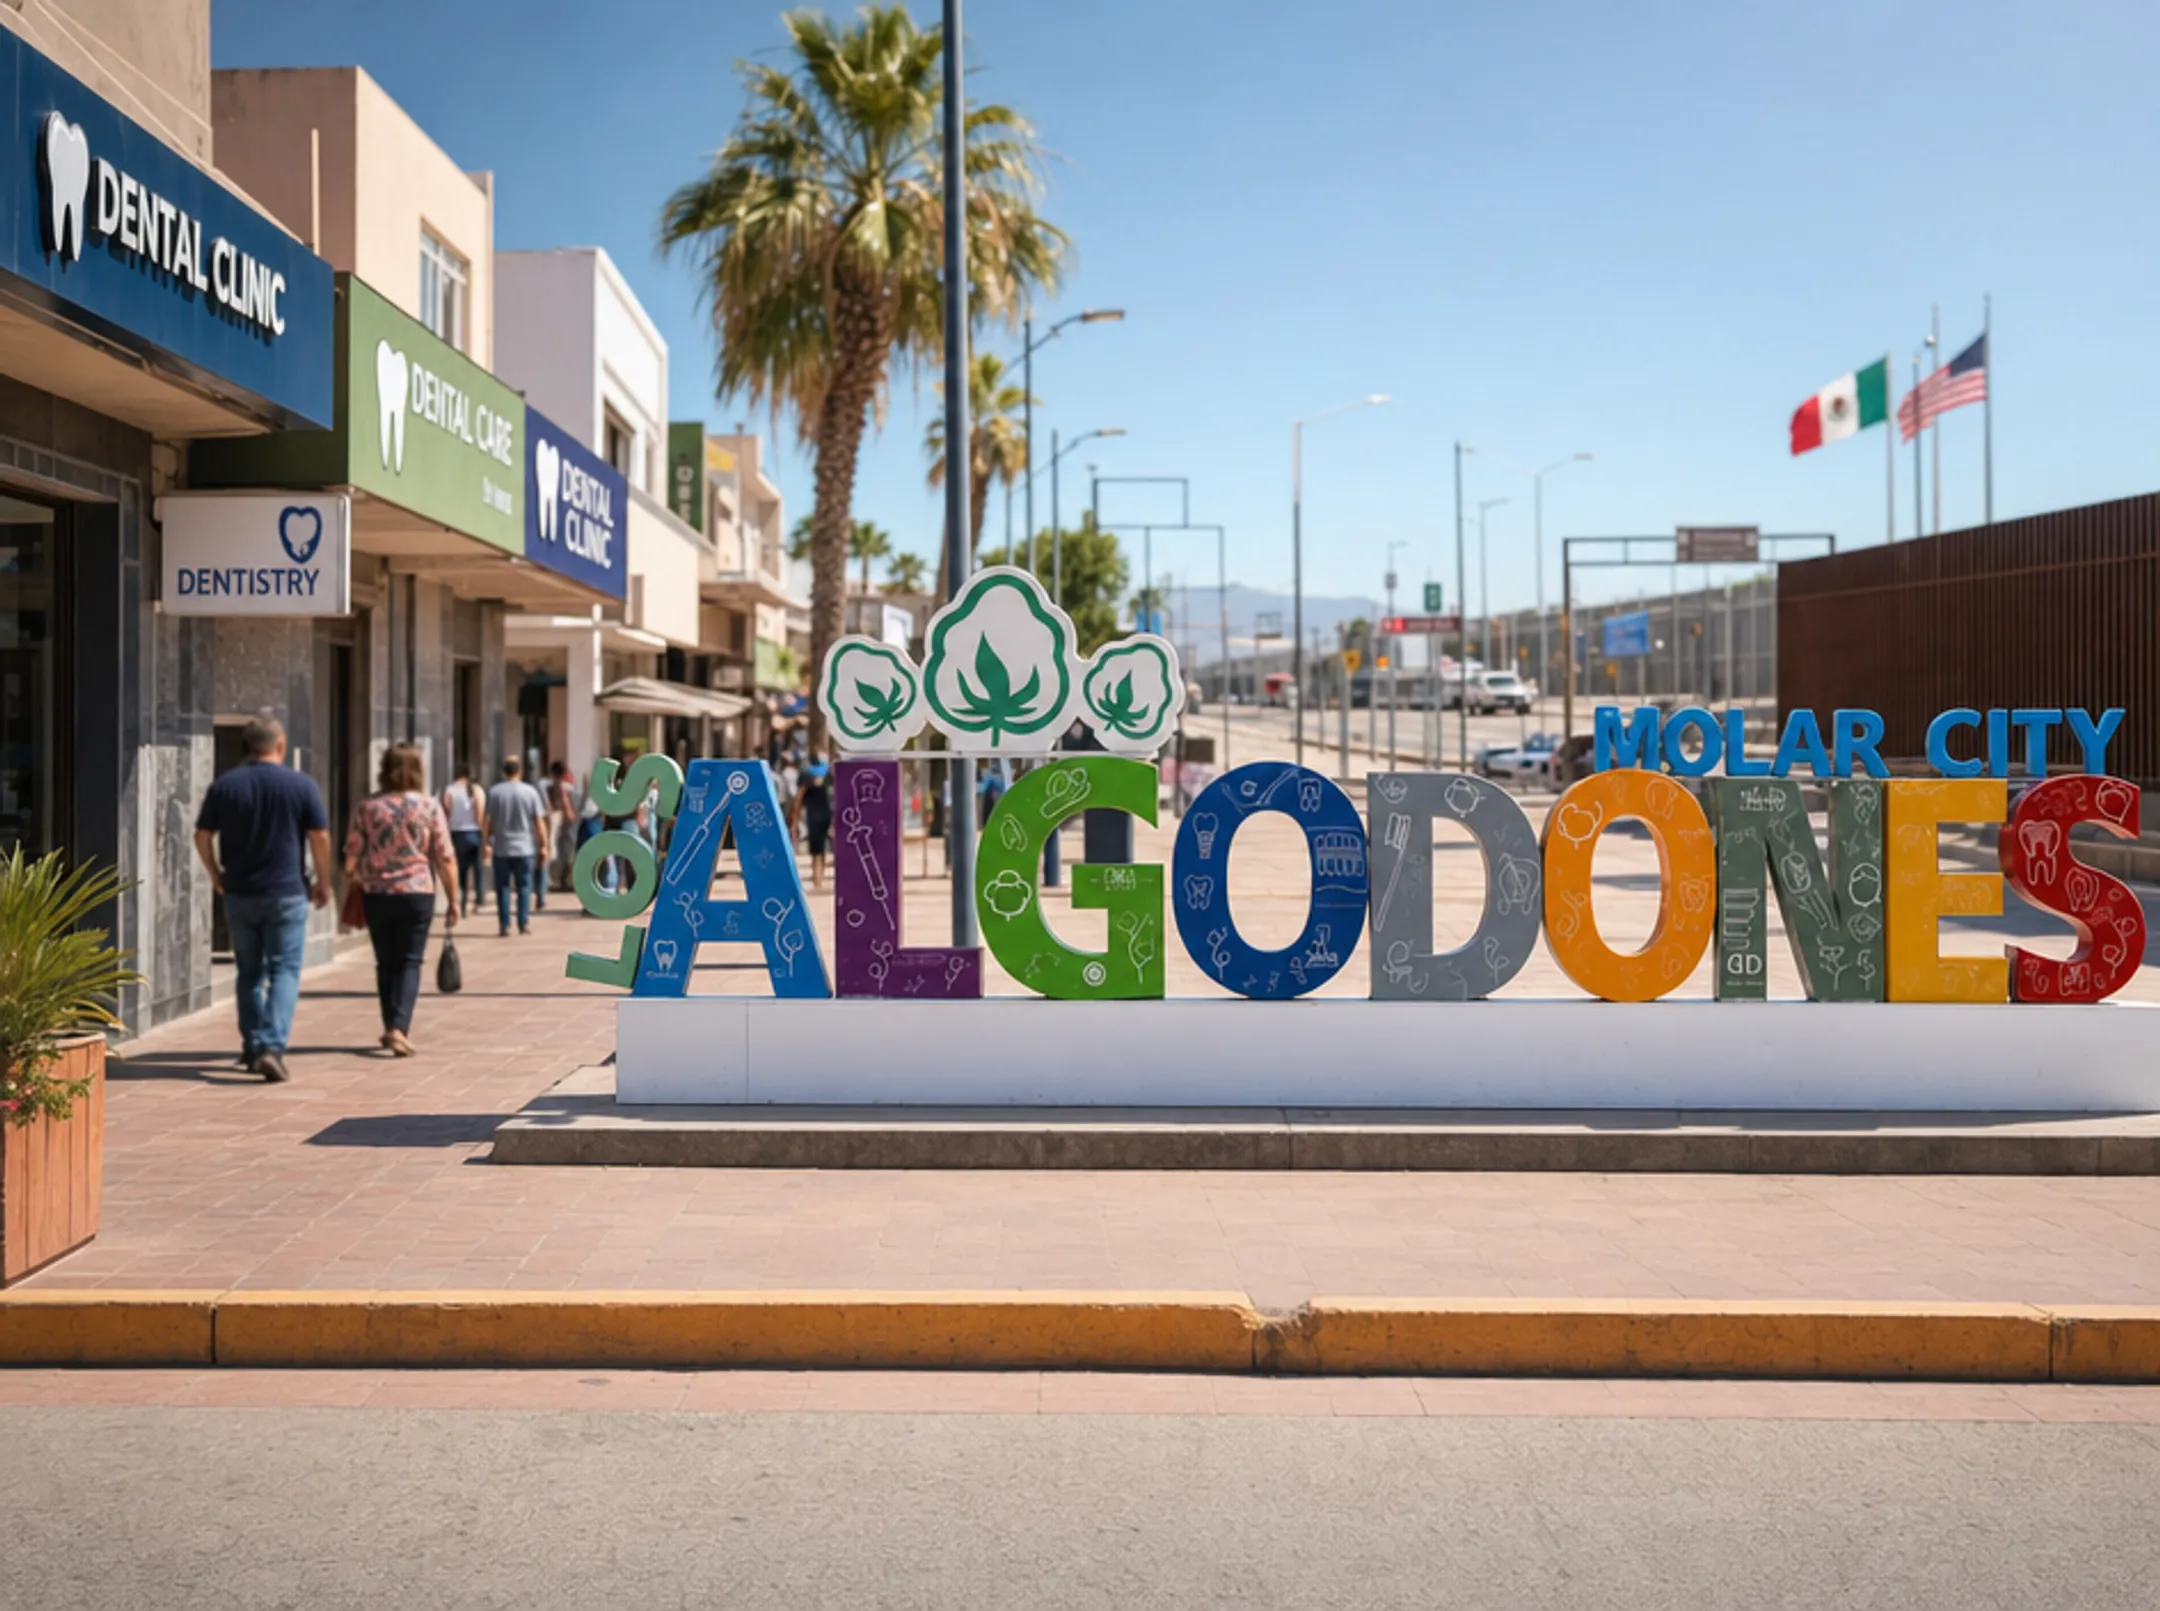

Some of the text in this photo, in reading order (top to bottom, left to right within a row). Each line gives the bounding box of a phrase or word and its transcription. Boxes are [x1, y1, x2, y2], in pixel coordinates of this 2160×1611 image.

[97, 156, 286, 336] DENTAL CLINIC
[411, 361, 474, 445] DENTAL
[562, 458, 615, 528] DENTAL
[564, 508, 612, 569] CLINIC
[177, 568, 320, 596] DENTISTRY
[1593, 705, 2127, 779] MOLAR CITY
[565, 753, 686, 989] LOS
[630, 755, 2146, 1003] ALGODONES
